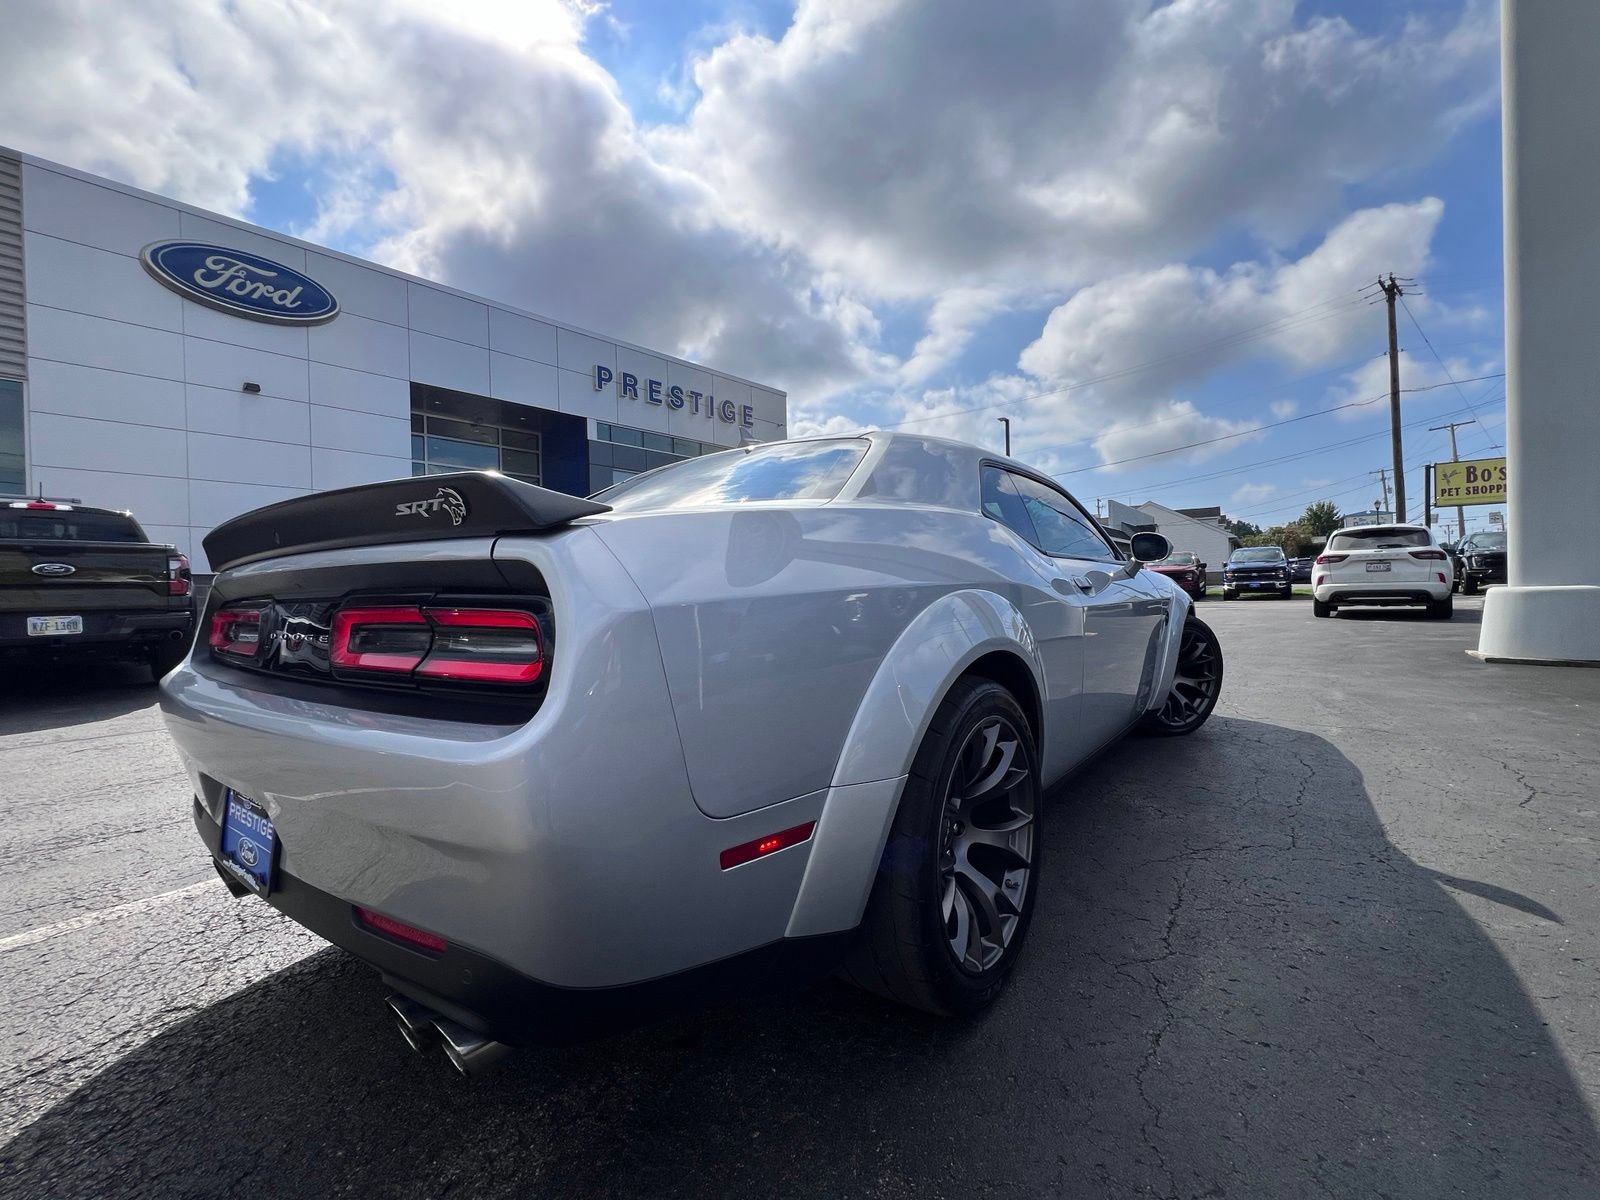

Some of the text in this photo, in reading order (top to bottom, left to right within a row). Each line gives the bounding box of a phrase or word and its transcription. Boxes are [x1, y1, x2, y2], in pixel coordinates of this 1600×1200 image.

[193, 255, 303, 308] Ford
[594, 364, 754, 427] PRESTIGE
[1441, 487, 1461, 497] PET
[395, 498, 445, 517] SRT
[270, 632, 329, 643] DODGE
[229, 802, 273, 840] PRESTIGE
